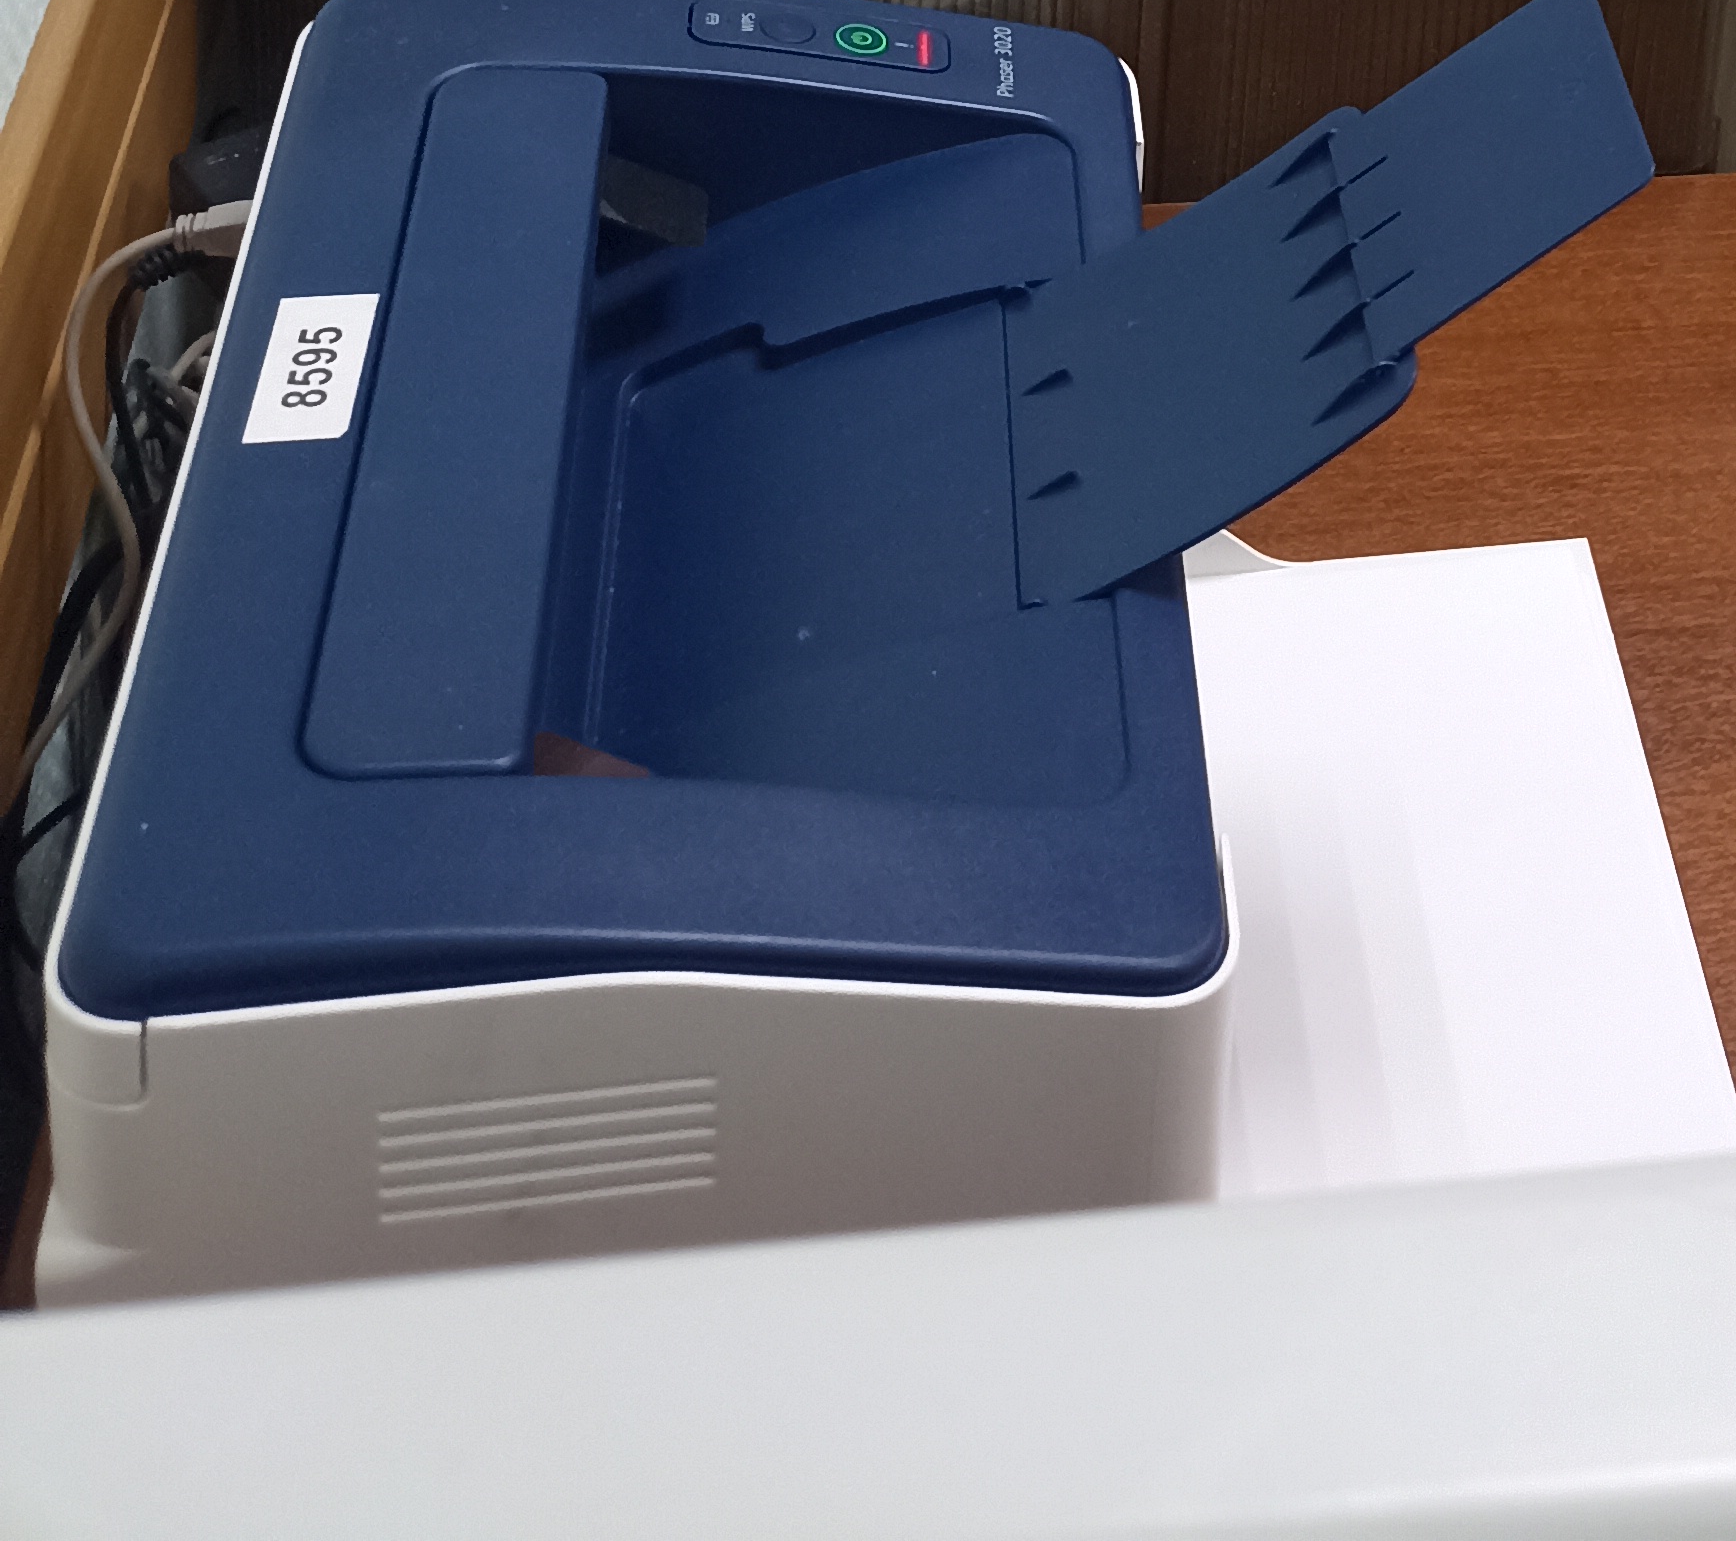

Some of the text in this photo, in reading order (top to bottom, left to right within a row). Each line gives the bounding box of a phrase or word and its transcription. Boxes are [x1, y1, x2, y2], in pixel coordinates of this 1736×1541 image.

[740, 12, 756, 32] WPS
[993, 26, 1015, 98] Phaser 3020
[280, 326, 343, 408] 8595
